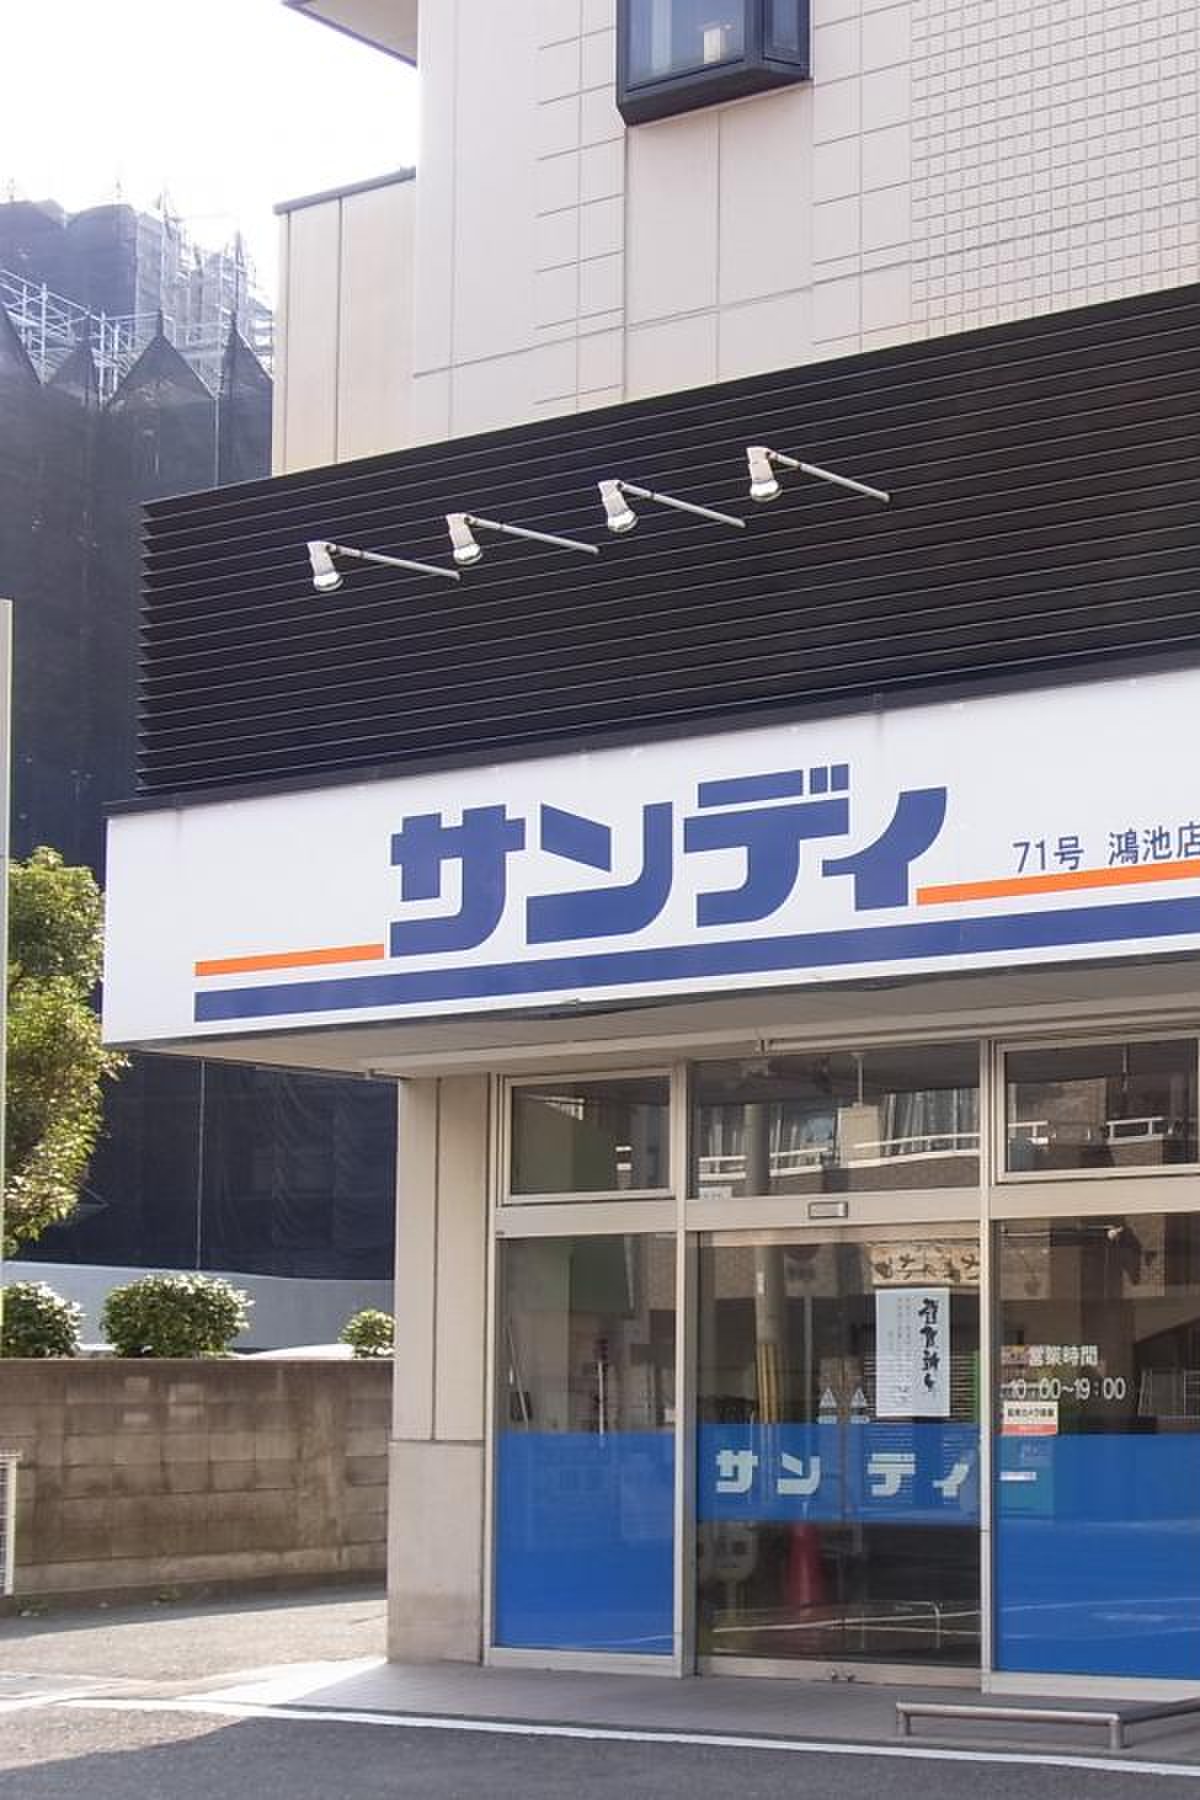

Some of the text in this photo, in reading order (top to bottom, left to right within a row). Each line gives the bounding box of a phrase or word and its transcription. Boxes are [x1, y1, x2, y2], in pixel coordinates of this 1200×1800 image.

[390, 763, 947, 957] サンディ
[1013, 836, 1084, 873] 71号
[1029, 1344, 1099, 1367] 営業時間
[716, 1449, 969, 1497] サンディ
